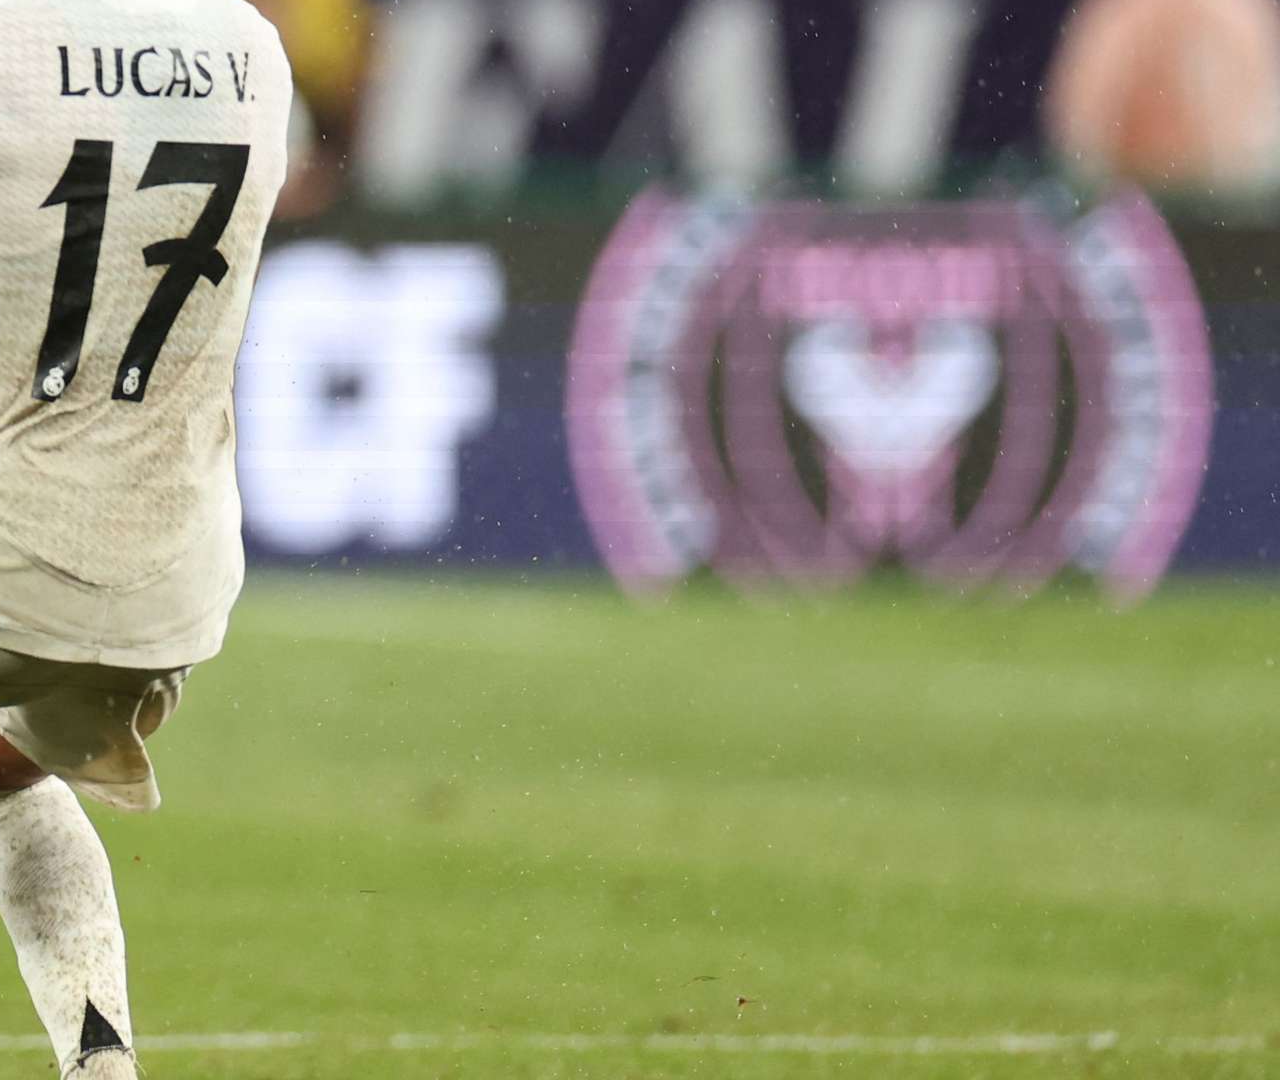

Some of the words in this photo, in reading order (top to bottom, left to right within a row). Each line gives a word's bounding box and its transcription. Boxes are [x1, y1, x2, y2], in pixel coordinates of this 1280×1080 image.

[56, 45, 214, 99] LUCAS
[226, 51, 255, 103] V.
[32, 138, 251, 403] 17
